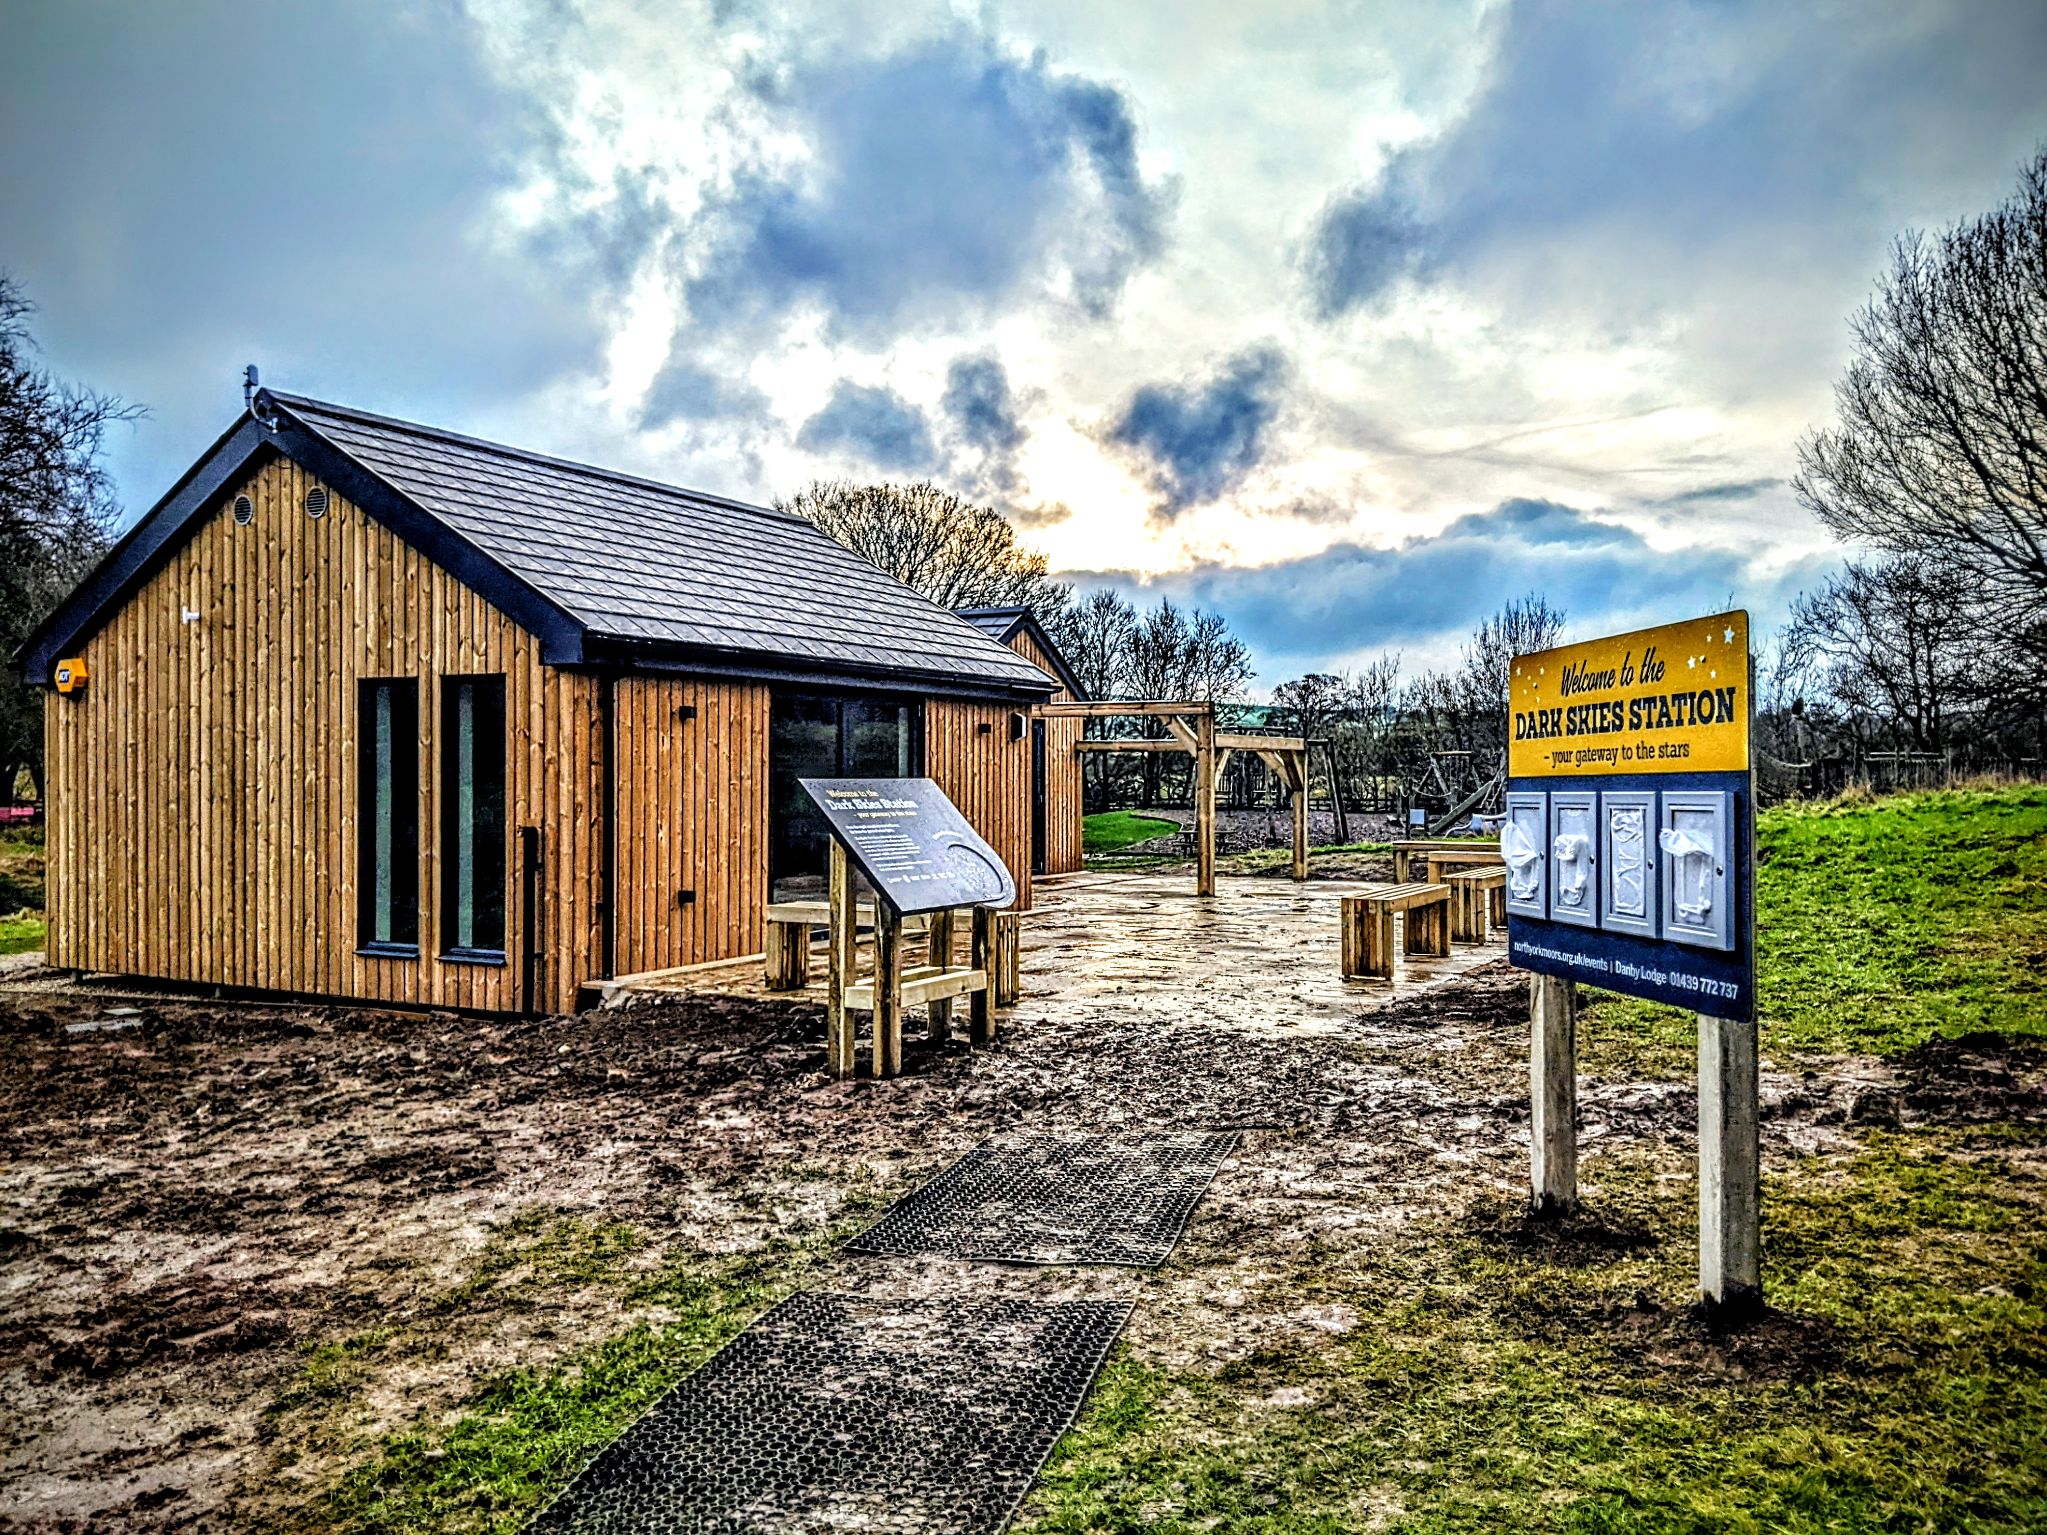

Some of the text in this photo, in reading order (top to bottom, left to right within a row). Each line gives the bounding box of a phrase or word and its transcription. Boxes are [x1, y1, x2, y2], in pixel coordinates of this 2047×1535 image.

[1561, 646, 1666, 697] Welcome to the
[1515, 687, 1737, 740] DARK SKIES STATION
[1551, 750, 1573, 768] your
[1575, 746, 1619, 767] gateway
[1621, 744, 1633, 760] to
[1635, 741, 1656, 759] the
[1657, 743, 1690, 759] stars
[825, 798, 919, 810] Dark Skies Station
[1514, 941, 1608, 971] northyorkmoors.org.uk/events
[1615, 960, 1640, 980] Danby
[1640, 965, 1667, 984] Lodge
[1669, 971, 1699, 991] 01439
[1699, 978, 1719, 995] 772
[1719, 982, 1738, 1000] 737
